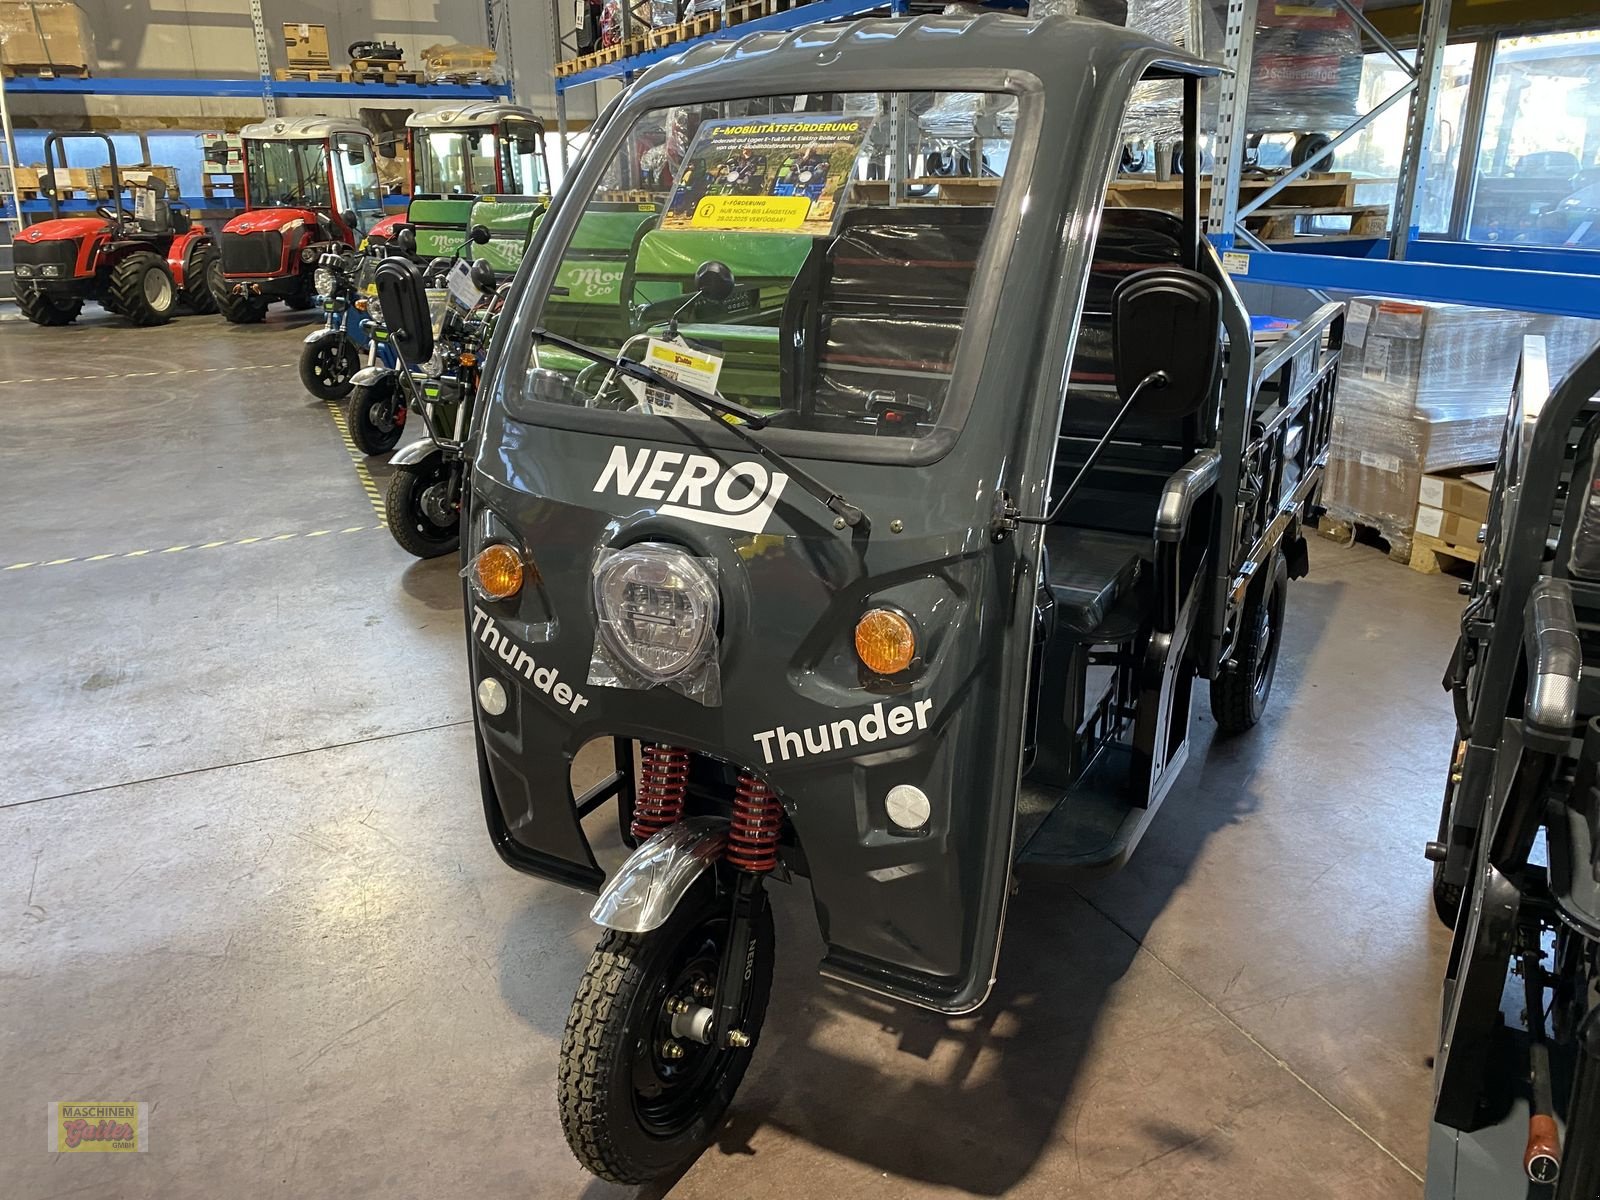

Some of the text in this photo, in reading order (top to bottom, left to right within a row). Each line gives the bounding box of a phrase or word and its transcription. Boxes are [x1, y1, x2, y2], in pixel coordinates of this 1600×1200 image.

[568, 268, 624, 286] Mov
[585, 284, 614, 297] Eco
[592, 445, 771, 514] NERO
[471, 605, 589, 715] Thunder
[753, 697, 933, 764] Thunder
[744, 939, 757, 980] NERO
